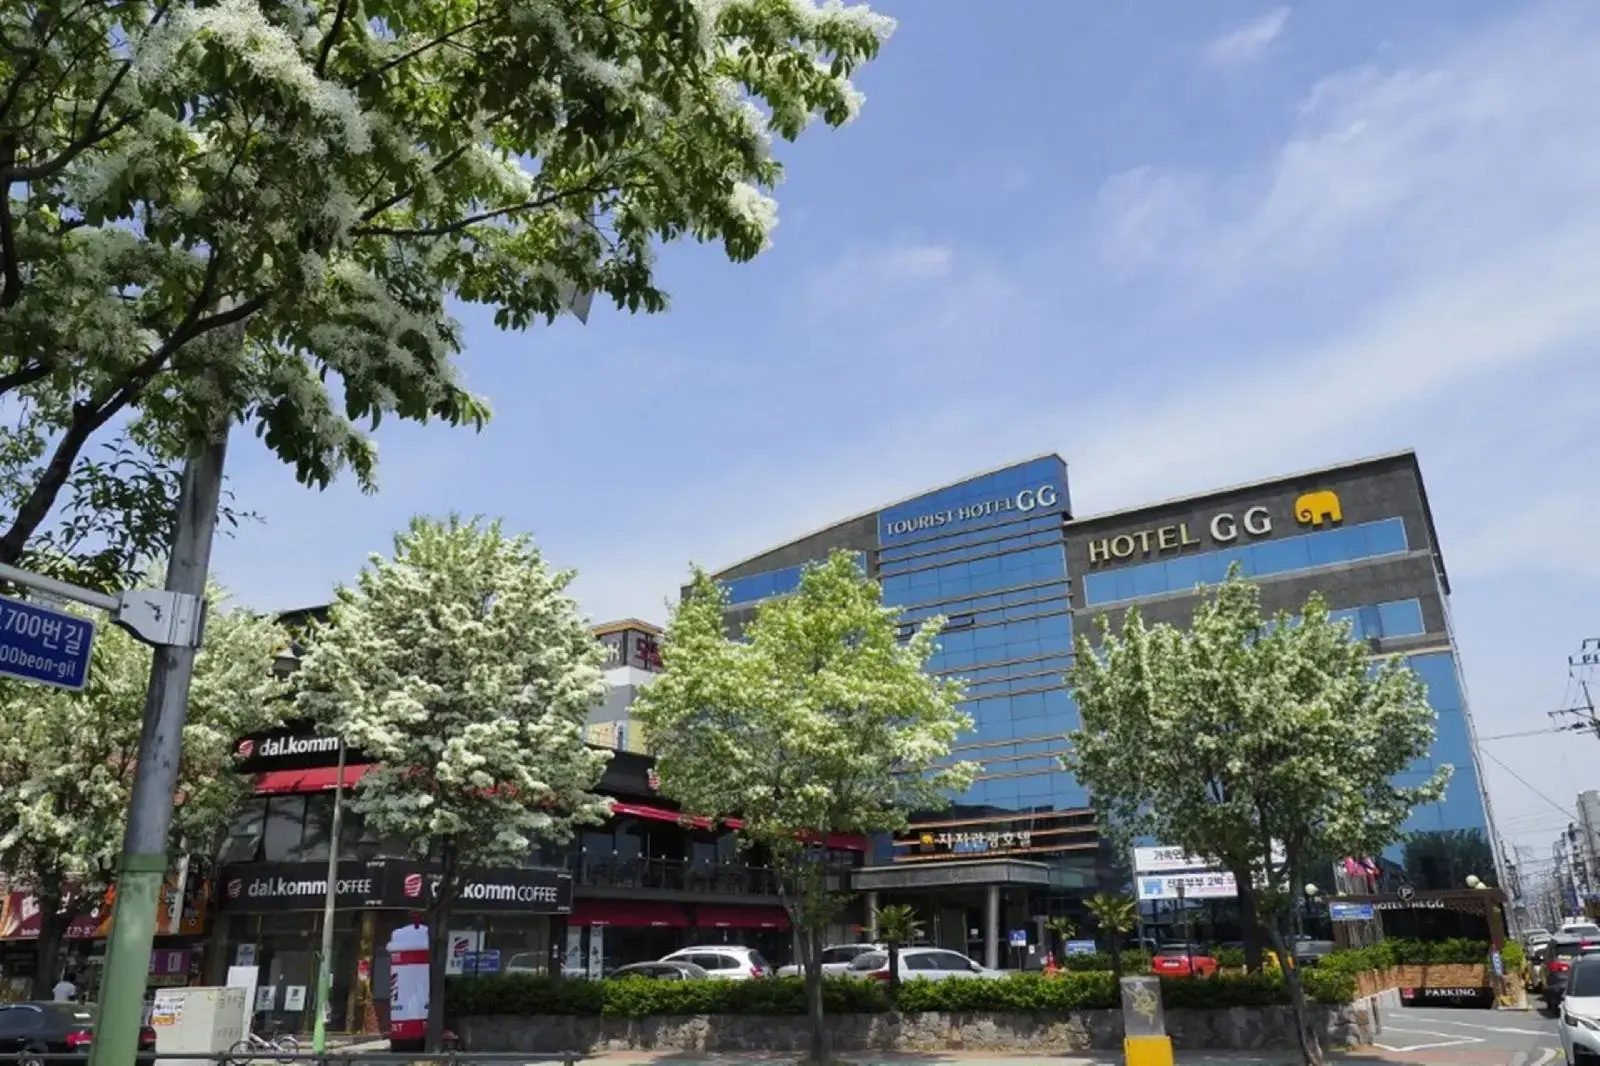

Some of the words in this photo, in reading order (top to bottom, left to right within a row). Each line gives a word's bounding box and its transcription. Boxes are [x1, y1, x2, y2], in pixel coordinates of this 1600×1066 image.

[886, 510, 953, 536] TOURIST
[958, 497, 1014, 521] HOTEL
[1016, 484, 1058, 512] GG
[1088, 522, 1200, 563] HOTEL
[1210, 506, 1273, 542] GG
[260, 735, 338, 757] dal.komm
[248, 877, 327, 897] dal.komm
[334, 879, 372, 895] OFFEE
[517, 885, 558, 903] COFFEE
[1425, 988, 1476, 997] PARKING
